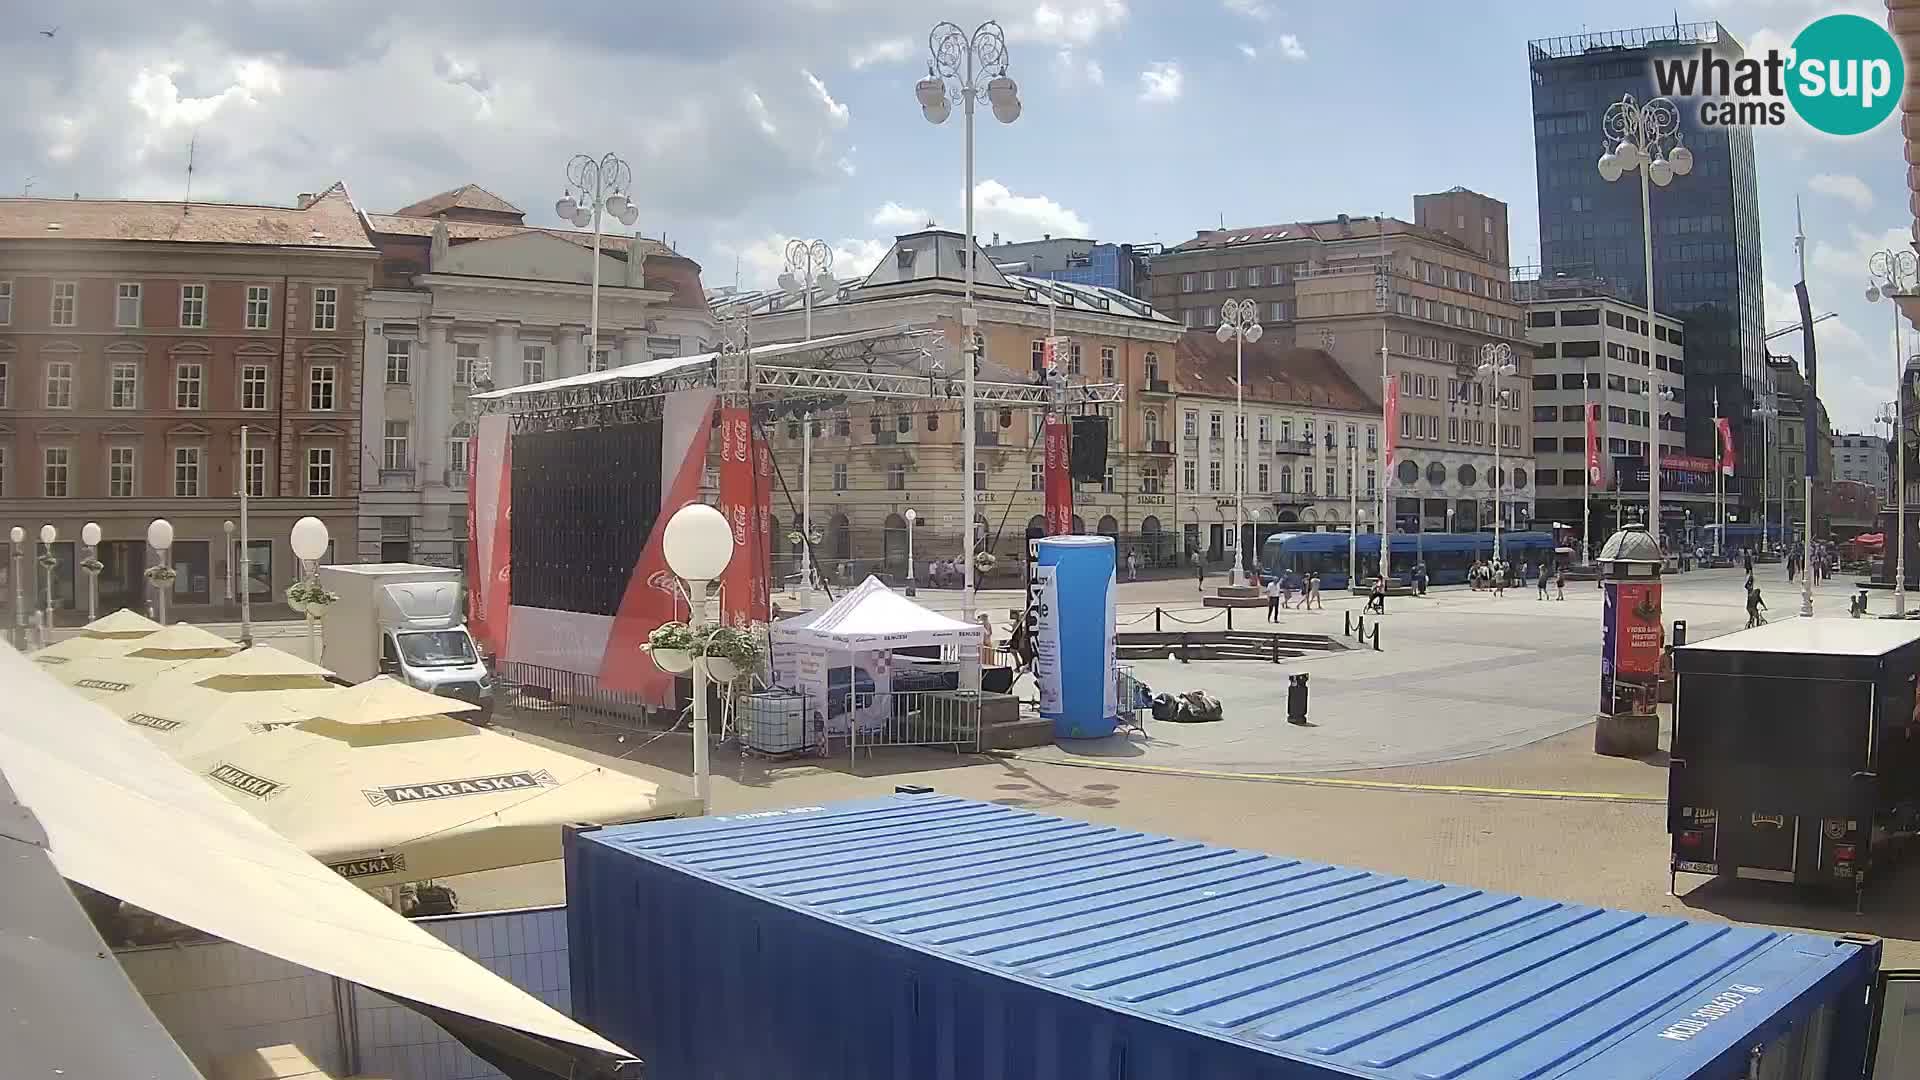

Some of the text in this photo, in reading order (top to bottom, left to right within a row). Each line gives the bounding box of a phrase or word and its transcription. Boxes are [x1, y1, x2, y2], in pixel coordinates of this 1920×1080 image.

[217, 765, 274, 796] MARASKA
[395, 775, 529, 801] MARASKA
[336, 859, 391, 877] RASKA
